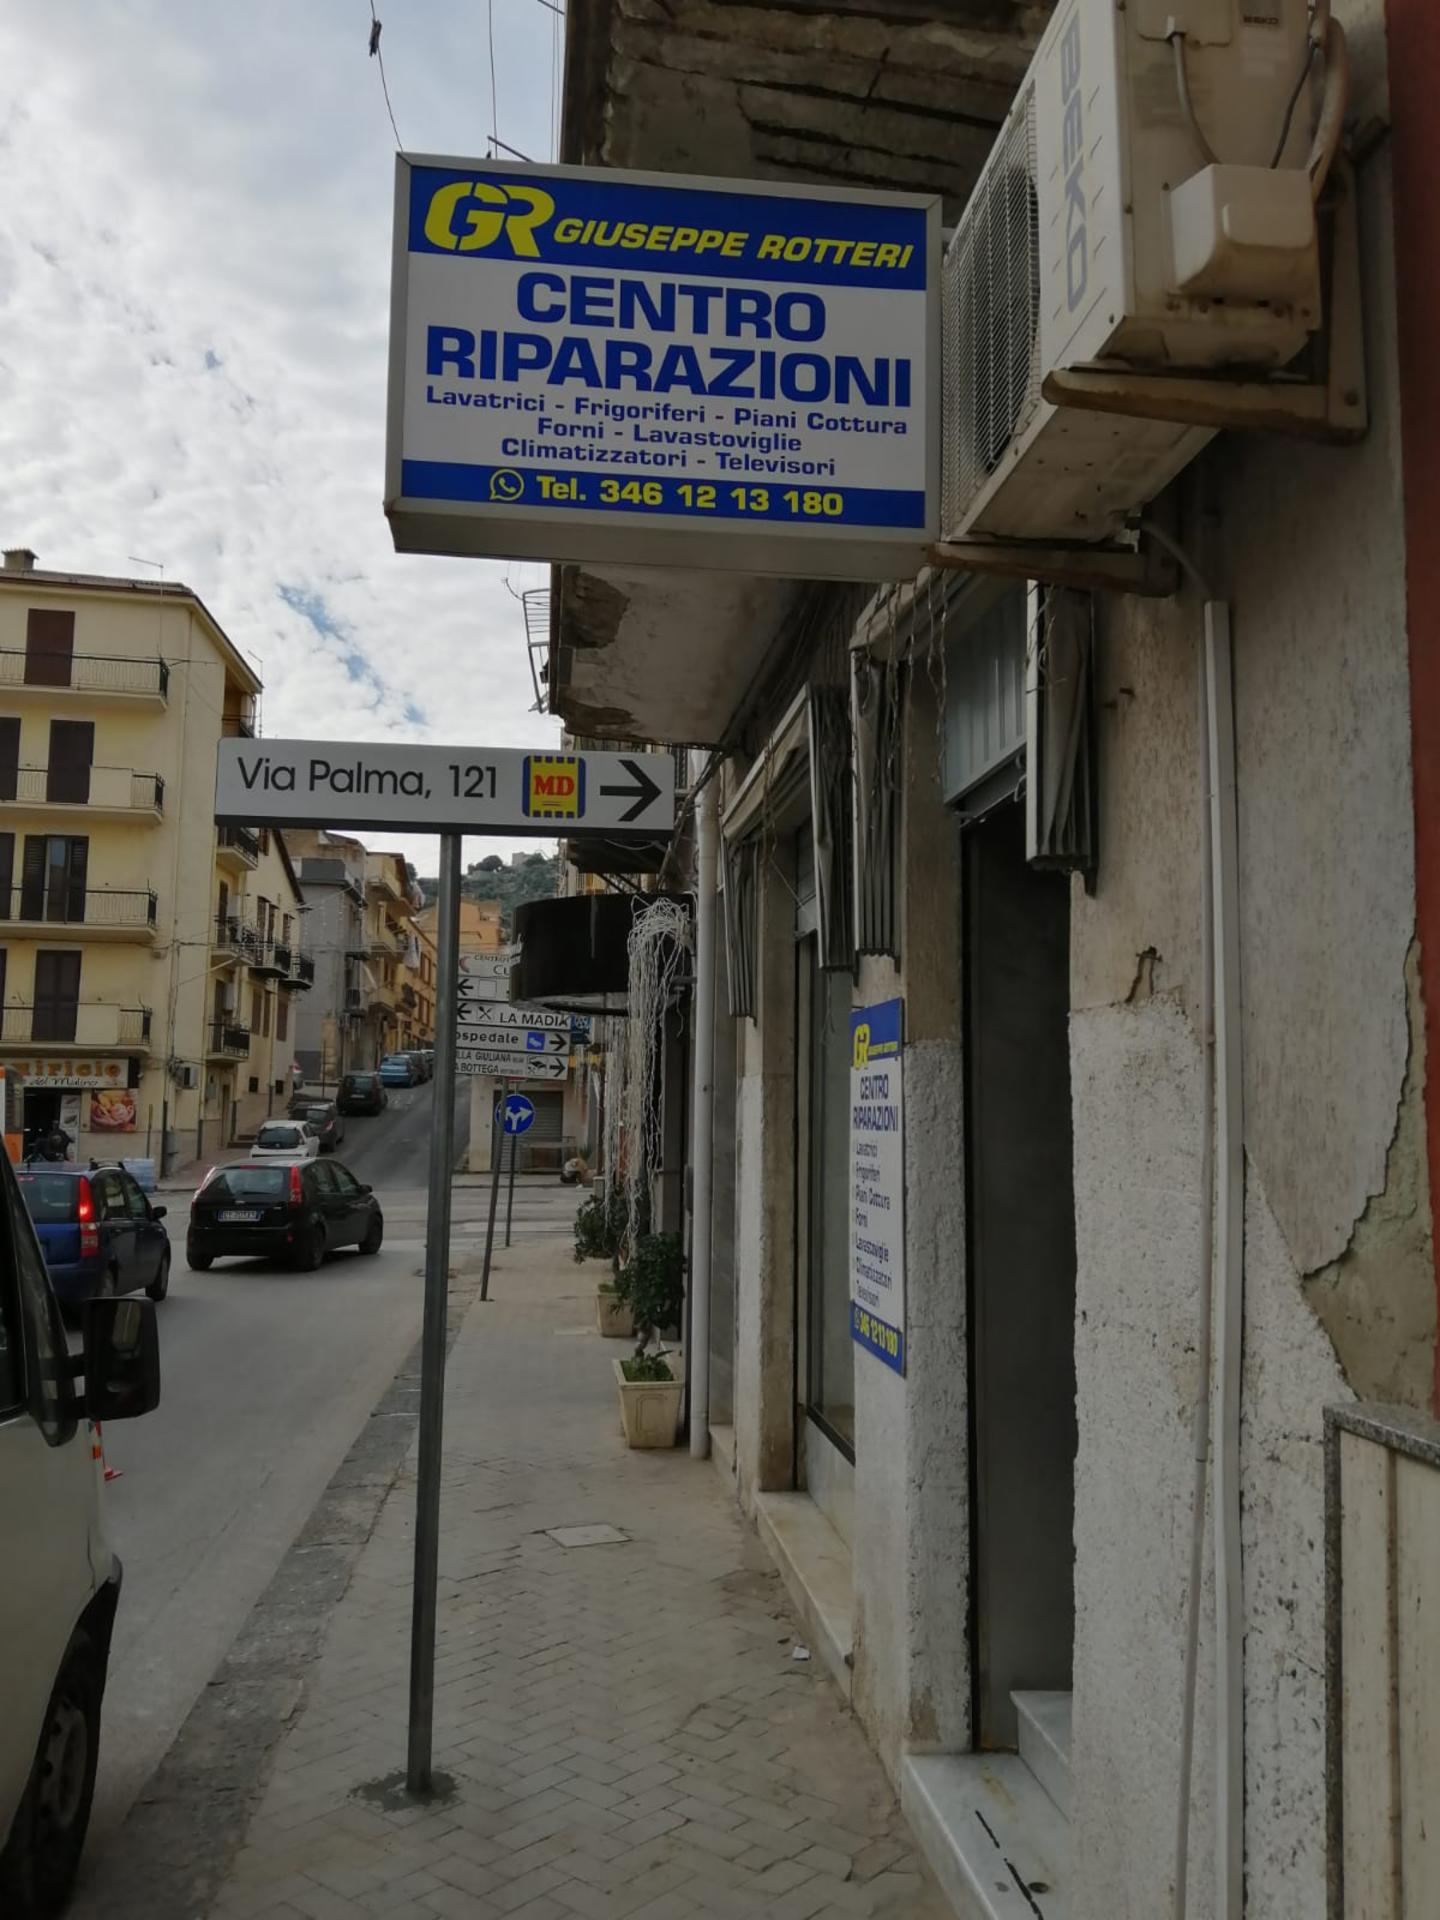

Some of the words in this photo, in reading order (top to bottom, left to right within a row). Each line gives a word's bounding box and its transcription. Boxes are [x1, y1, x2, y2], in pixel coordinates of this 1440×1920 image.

[424, 181, 558, 258] GR
[553, 217, 749, 258] GIUSEPPE
[757, 234, 914, 270] ROTTERI
[517, 271, 826, 342] CENTRO
[426, 325, 911, 408] RIPARAZIONI
[426, 386, 545, 412] Lavatrici
[574, 397, 706, 424] Frigoriferi
[734, 407, 797, 429] Piani
[806, 412, 908, 436] Cottura
[537, 418, 604, 439] Forni
[633, 424, 802, 454] Lavastoviglie
[501, 437, 688, 467] Climatizzatori
[716, 452, 836, 477] Televisori
[536, 475, 587, 501] Tel.
[600, 479, 663, 506] 346
[677, 484, 717, 508] 12
[731, 487, 770, 511] 13
[784, 491, 844, 517] 180
[237, 756, 296, 791] Via
[309, 759, 432, 800] Palma,
[448, 764, 497, 799] 121
[534, 775, 574, 796] MD
[500, 1013, 517, 1024] LA
[521, 1013, 568, 1027] MADIA
[461, 1062, 499, 1074] BOTTEGA
[860, 1074, 889, 1101] CENTRO
[853, 1105, 899, 1132] RIPARAZIONI
